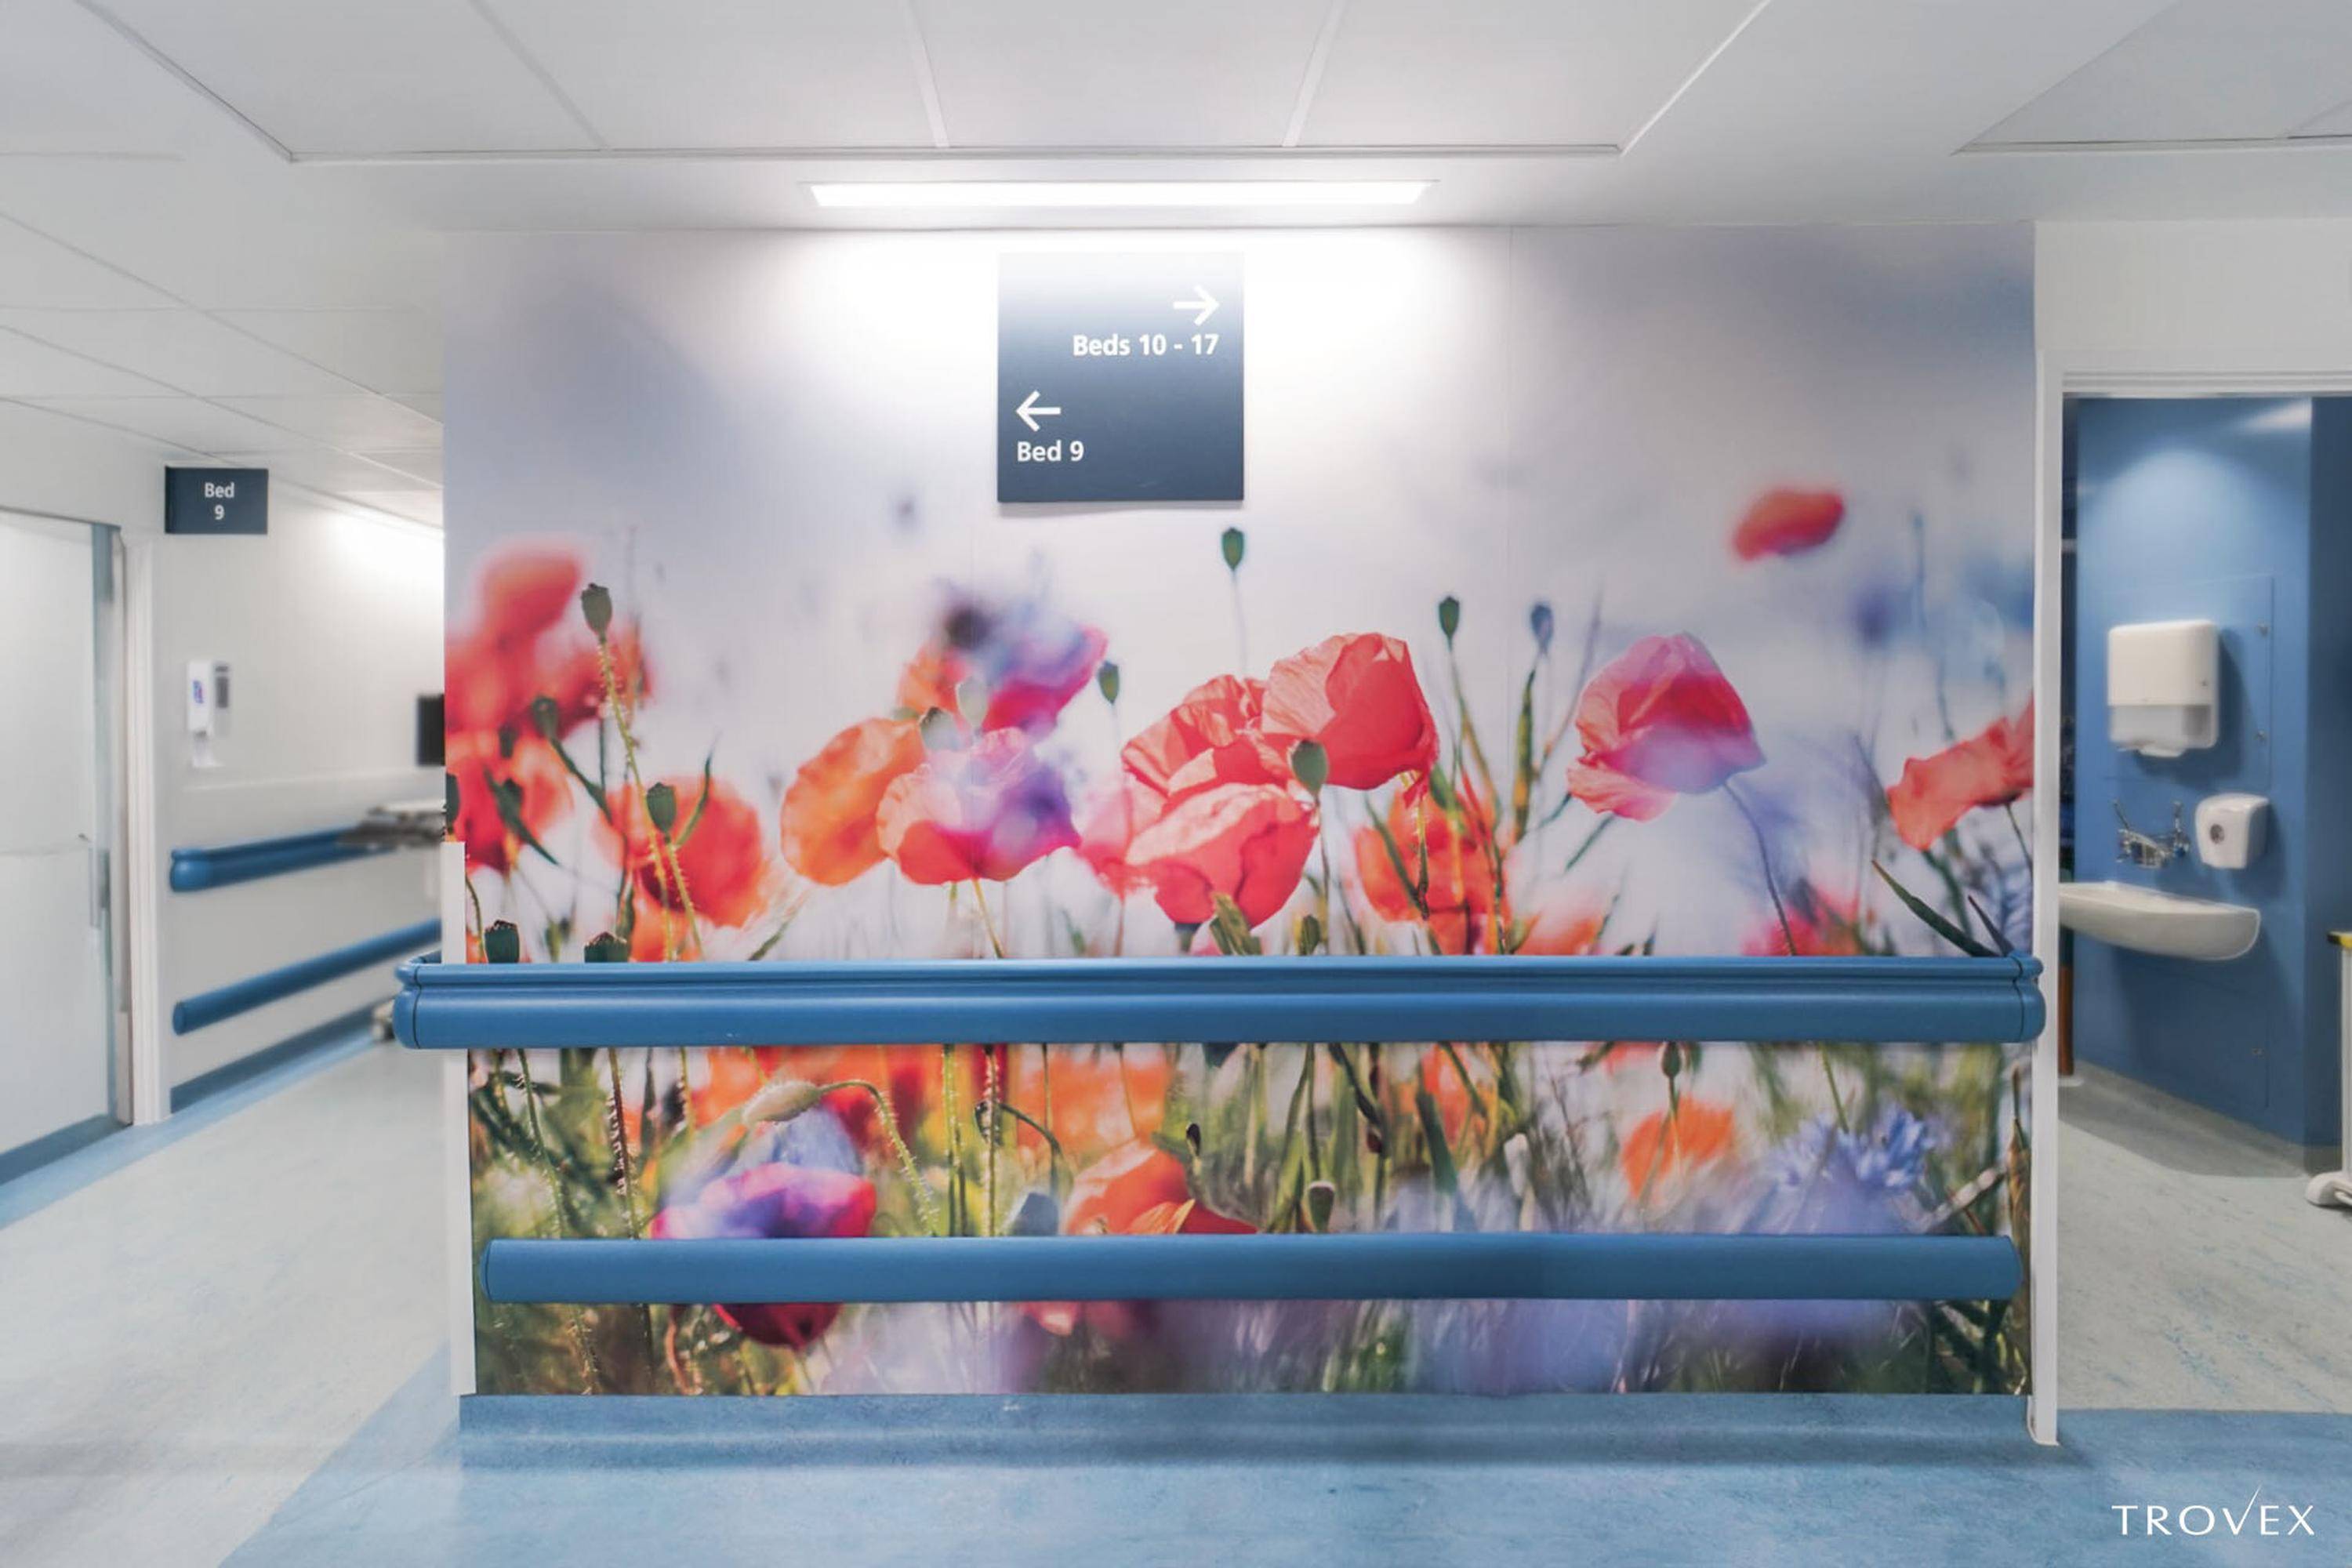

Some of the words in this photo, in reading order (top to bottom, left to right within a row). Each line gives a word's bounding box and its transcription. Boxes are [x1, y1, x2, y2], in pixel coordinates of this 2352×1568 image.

[1073, 334, 1131, 356] Beds
[1139, 334, 1167, 355] 10
[1191, 334, 1220, 355] 17
[1017, 440, 1062, 462] Bed
[1070, 441, 1084, 461] 9
[205, 482, 235, 498] Bed
[214, 505, 225, 520] 9
